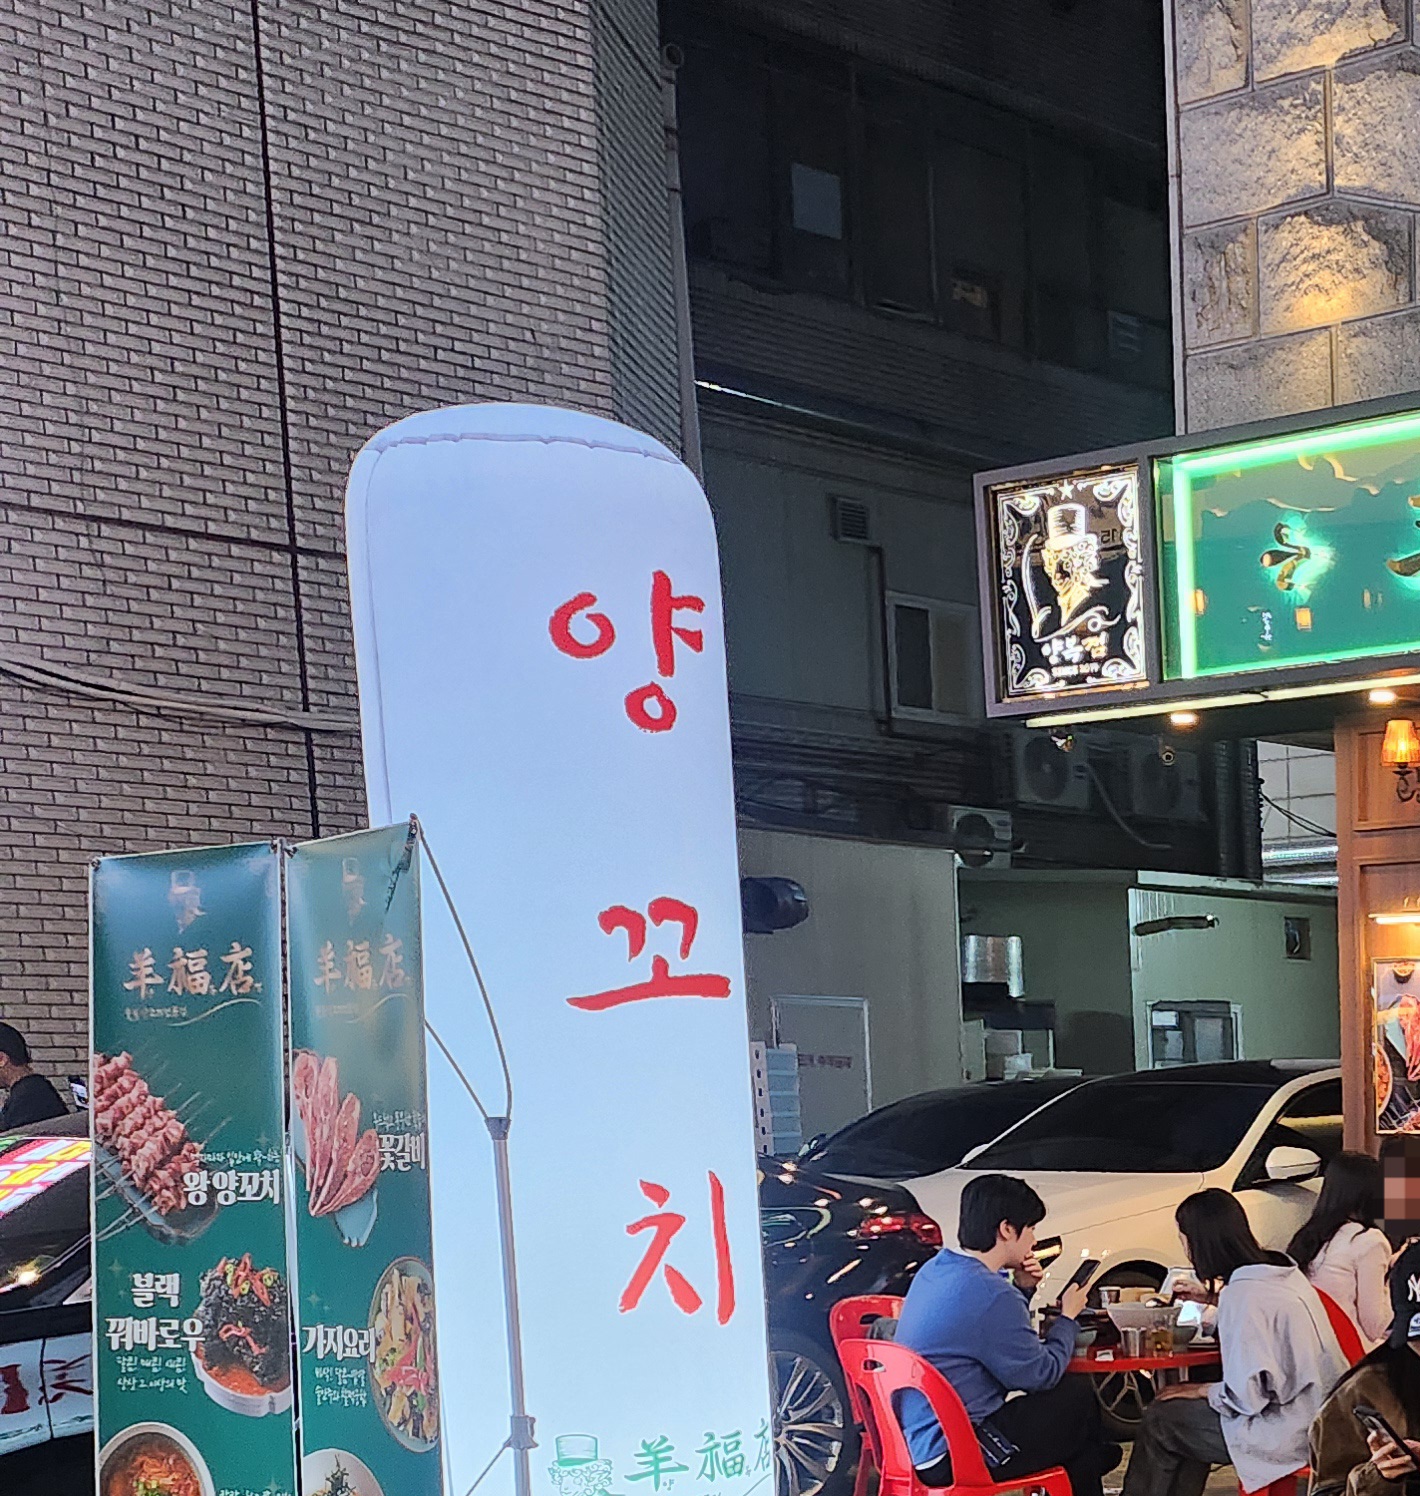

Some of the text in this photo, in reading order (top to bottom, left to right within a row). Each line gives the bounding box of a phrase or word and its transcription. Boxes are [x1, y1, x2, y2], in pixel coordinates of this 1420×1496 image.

[1041, 631, 1109, 665] 양복점
[313, 933, 406, 994] 羊福店
[549, 569, 735, 1325] 양꼬치
[123, 941, 256, 999] 羊福店
[378, 1132, 426, 1172] 꽃갈비
[131, 1272, 180, 1308] 블랙
[105, 1316, 206, 1352] 꿔바로우
[302, 1325, 376, 1363] 가지요리
[117, 1376, 137, 1391] 상상
[624, 1417, 771, 1492] 羊福店
